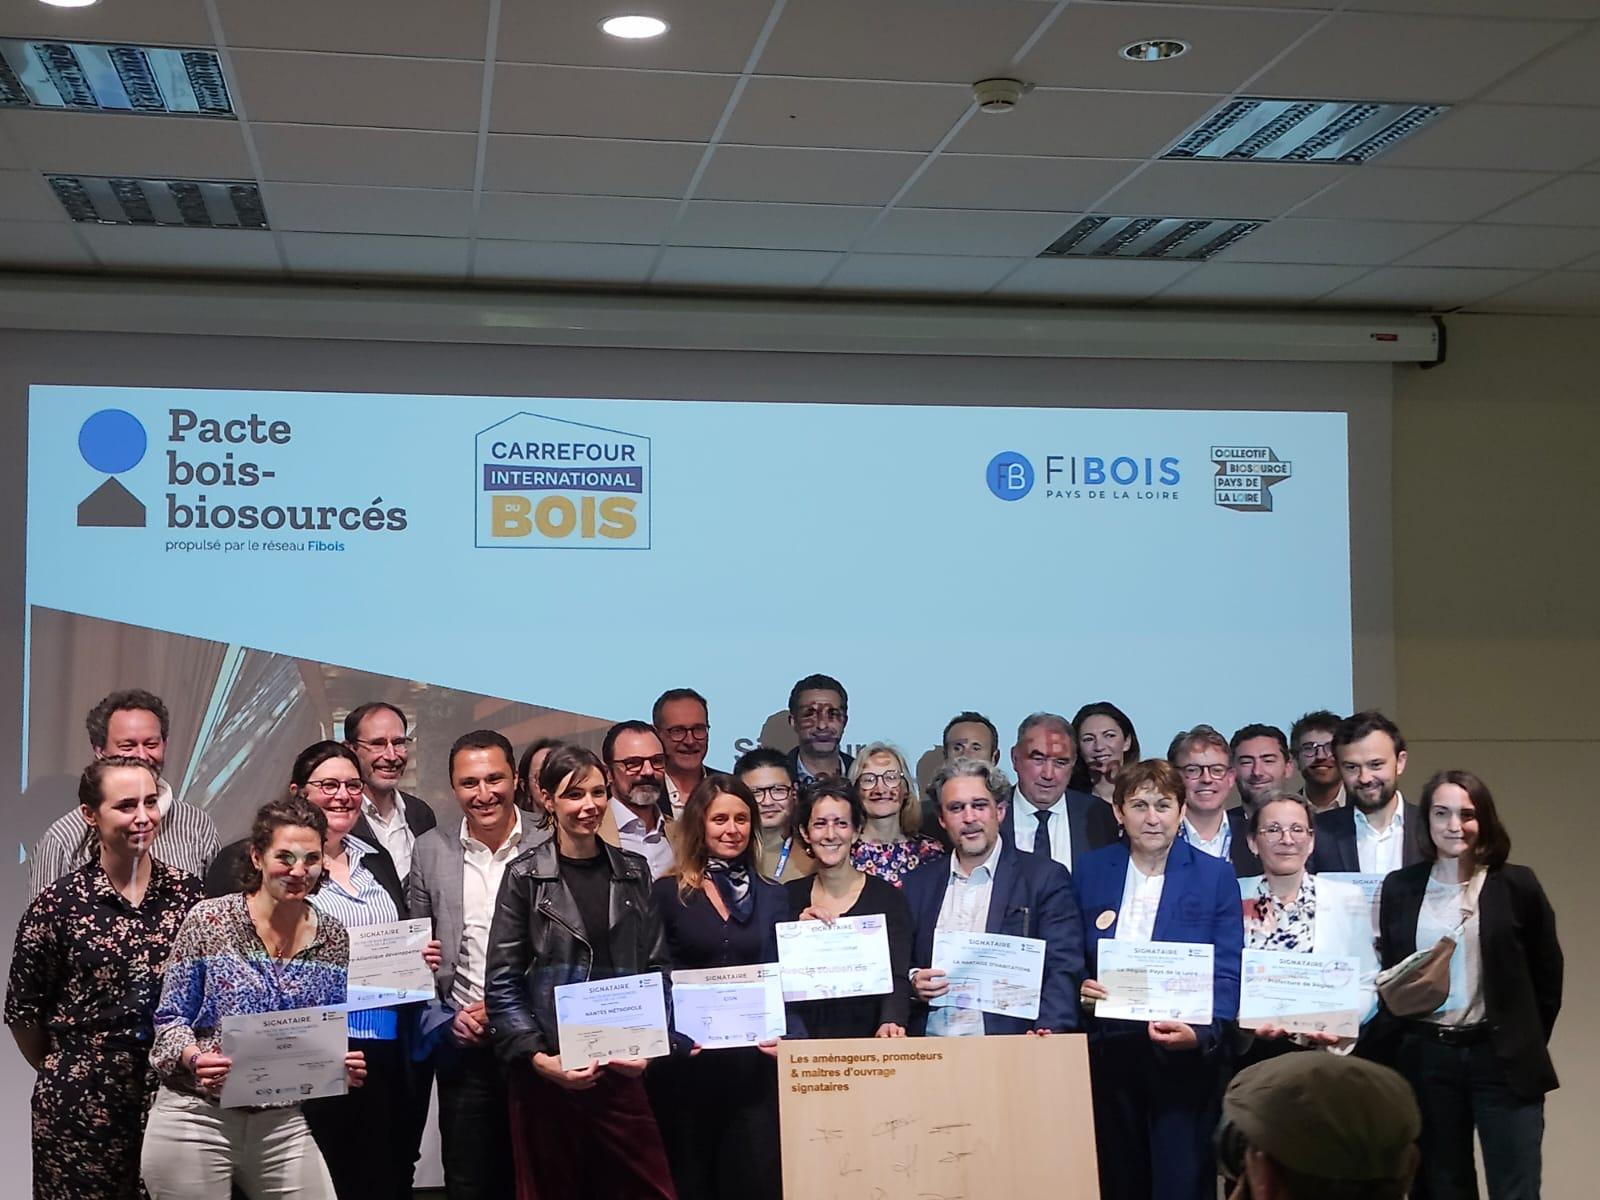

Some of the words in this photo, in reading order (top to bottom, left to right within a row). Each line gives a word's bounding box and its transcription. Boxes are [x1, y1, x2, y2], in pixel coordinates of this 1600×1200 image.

[168, 408, 291, 444] Pacte
[491, 441, 636, 461] CARREFOUR
[1215, 449, 1267, 458] COLLECTIF
[166, 450, 276, 486] bois-
[1046, 455, 1181, 486] FIBOIS
[491, 470, 636, 486] INTERNATIONAL
[1218, 478, 1243, 488] PAYS
[1246, 478, 1259, 488] DE
[1046, 490, 1081, 499] PAYS
[1089, 490, 1105, 499] DE
[1113, 491, 1130, 500] LA
[1137, 491, 1179, 500] LOIRE
[1218, 493, 1230, 502] LA
[1233, 493, 1259, 502] LOIRE
[165, 493, 408, 531] biosourcés
[505, 504, 521, 512] DU
[491, 495, 637, 539] BOIS
[165, 539, 221, 553] propulsé
[224, 541, 244, 553] par
[248, 540, 259, 551] le
[262, 541, 304, 552] réseau
[308, 540, 345, 552] Fibois
[360, 929, 400, 939] SIGNATAIRE
[968, 939, 1011, 949] SIGNATAIRE
[1279, 959, 1324, 967] SIGNATAIRE
[705, 973, 748, 982] SIGNATAIRE
[588, 983, 629, 993] SIGNATAIRE
[263, 1016, 311, 1027] SIGNATAIRE
[790, 1054, 809, 1064] Les
[812, 1053, 879, 1065] aménageurs,
[882, 1052, 943, 1064] promoteurs
[790, 1068, 799, 1078] &
[801, 1067, 841, 1078] maîtres
[843, 1067, 896, 1078] d'ouvrage
[791, 1082, 850, 1094] signataires
